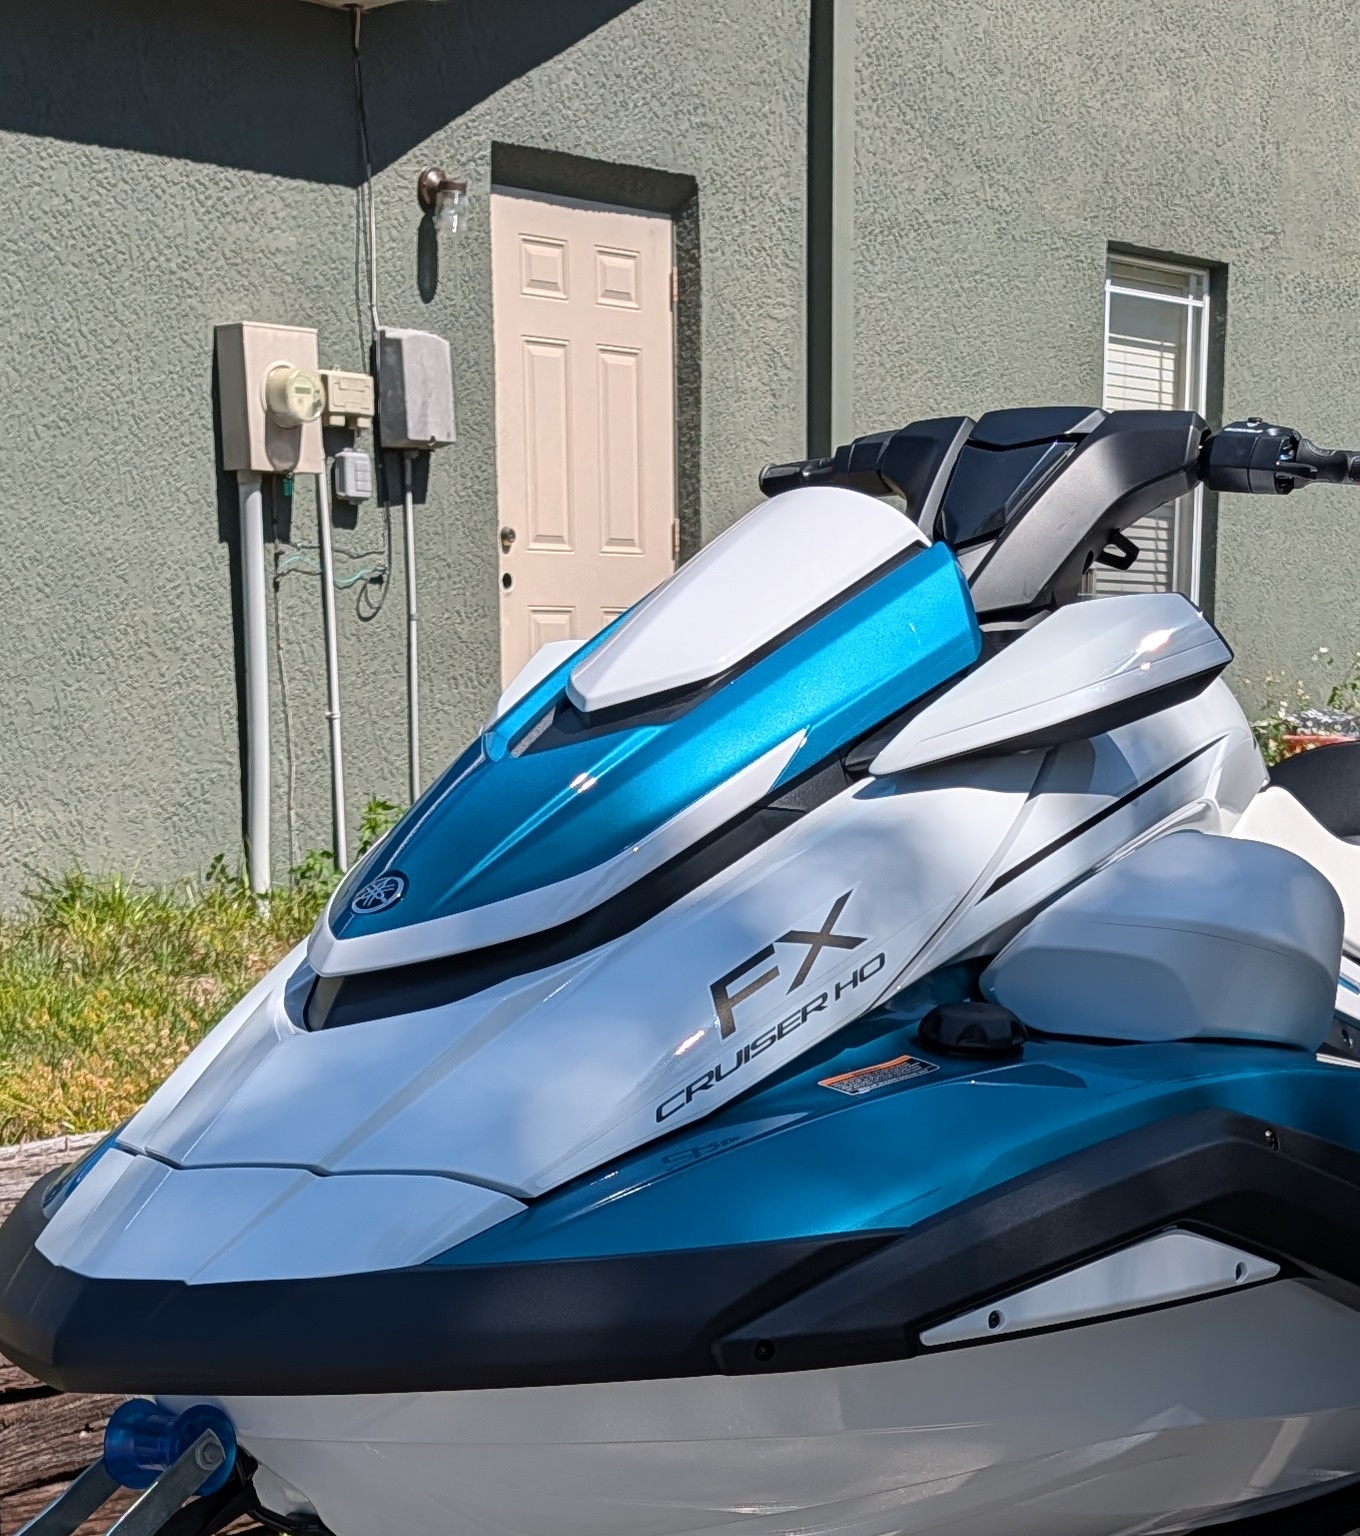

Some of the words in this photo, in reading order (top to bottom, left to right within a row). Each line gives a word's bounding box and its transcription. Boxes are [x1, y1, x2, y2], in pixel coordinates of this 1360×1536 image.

[655, 992, 829, 1123] CRUISER
[834, 952, 886, 1002] HO
[709, 888, 869, 1041] FX
